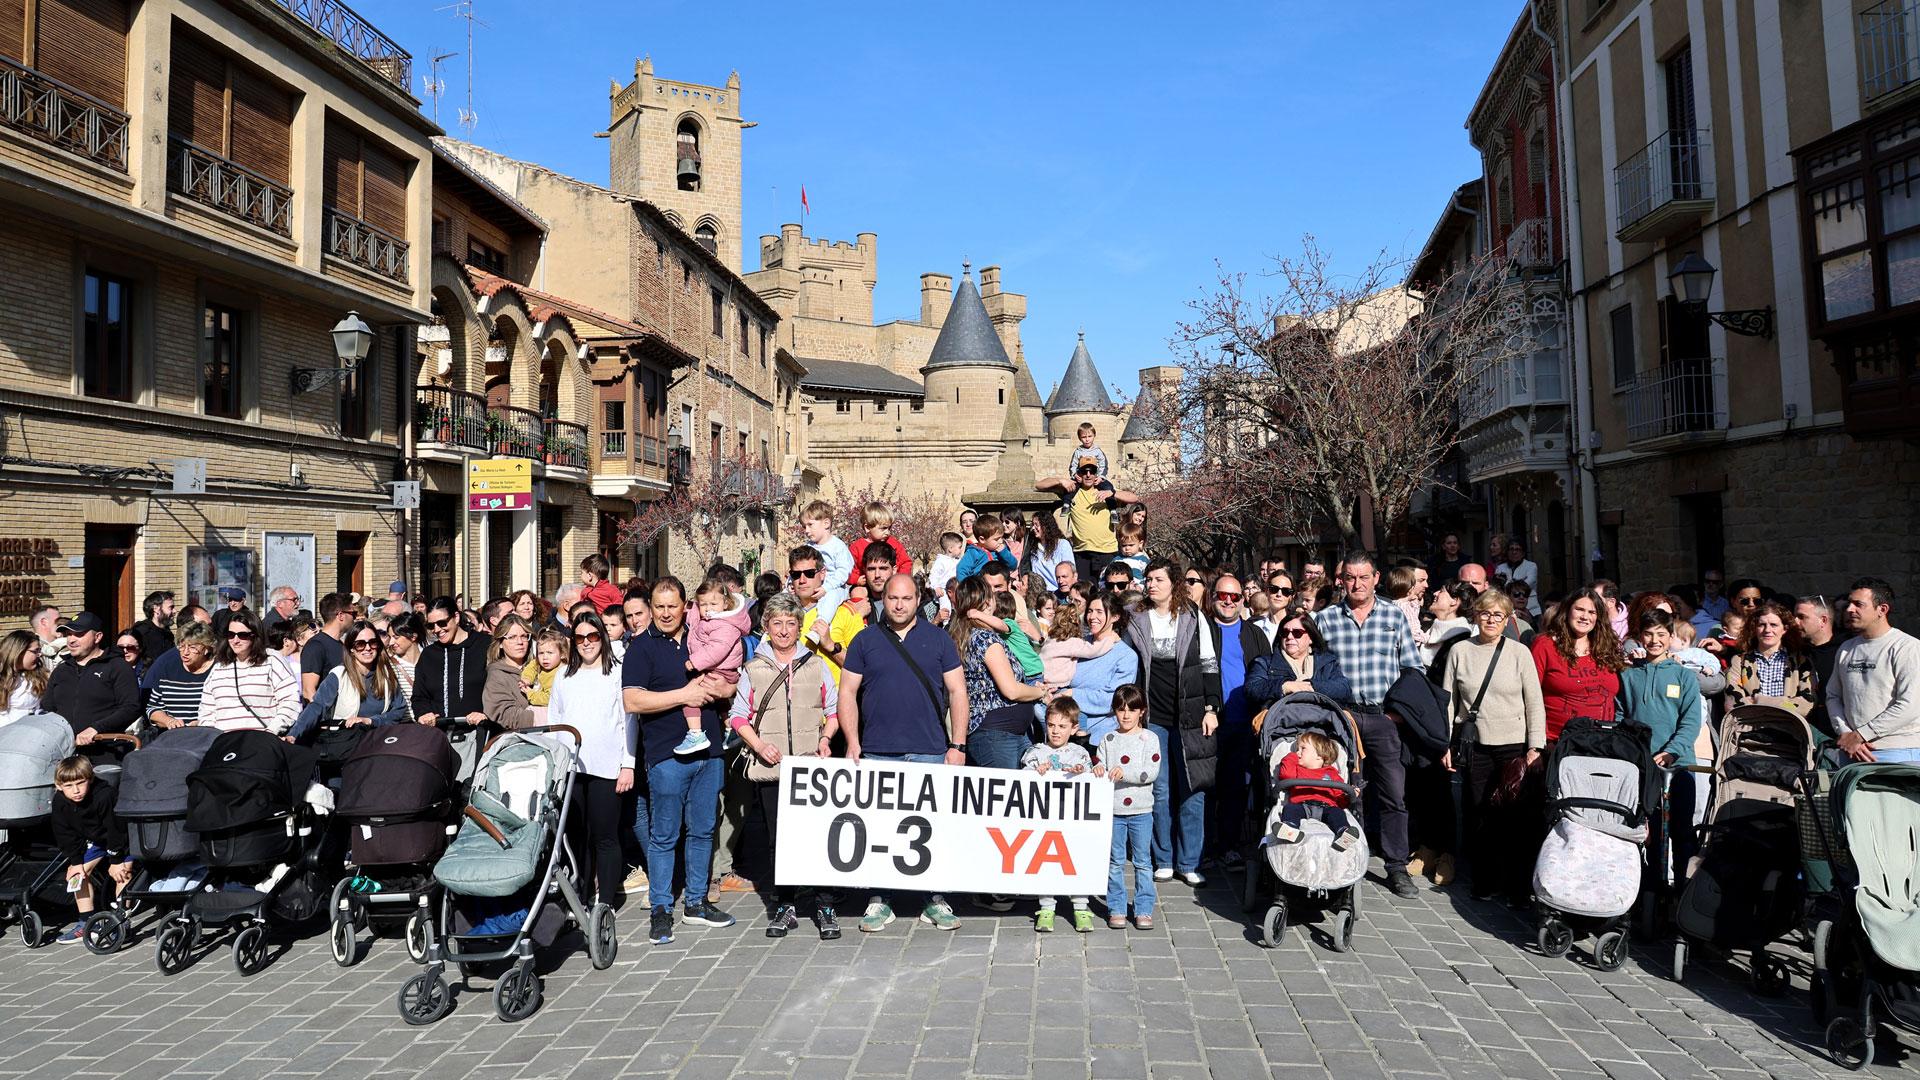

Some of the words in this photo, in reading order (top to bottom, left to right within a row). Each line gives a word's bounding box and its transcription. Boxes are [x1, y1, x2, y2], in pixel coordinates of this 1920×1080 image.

[0, 556, 51, 571] APITEL
[0, 579, 50, 595] APITEL
[789, 766, 938, 813] ESCUELA
[951, 775, 1101, 821] INFANTIL
[827, 812, 933, 876] 0-3
[986, 826, 1078, 876] YA
